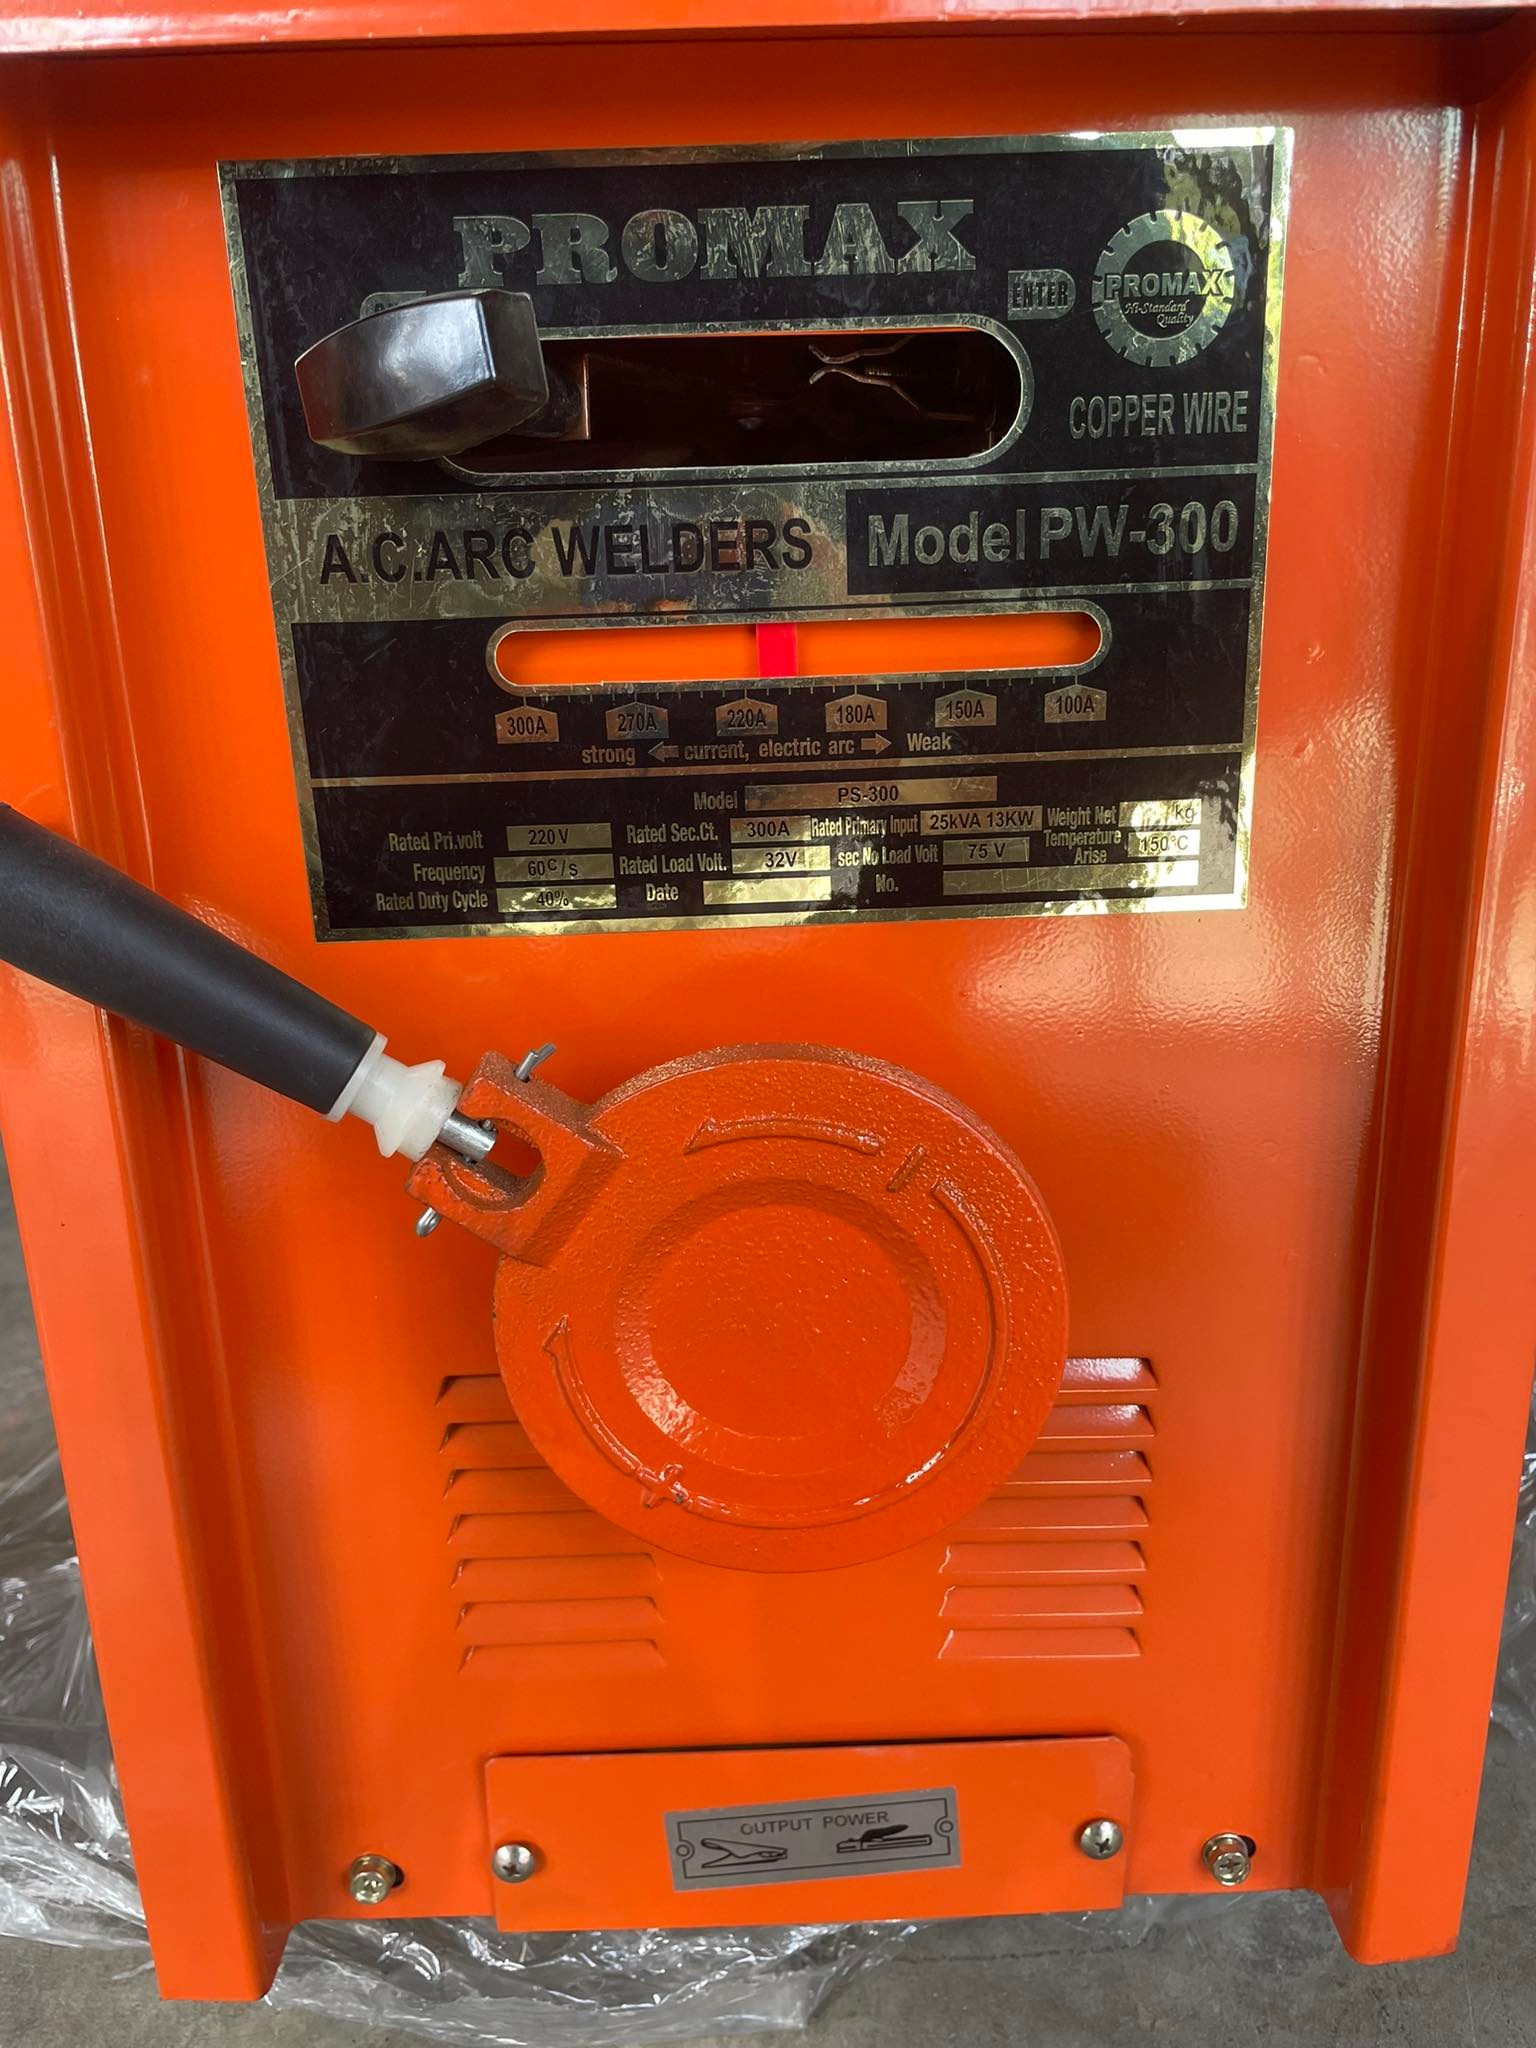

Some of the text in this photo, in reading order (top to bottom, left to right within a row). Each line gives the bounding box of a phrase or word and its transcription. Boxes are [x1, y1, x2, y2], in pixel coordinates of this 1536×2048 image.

[452, 199, 977, 288] PROMAX
[1013, 281, 1069, 308] ENTER
[1105, 271, 1223, 298] PROMAX
[1124, 300, 1190, 315] Hi-Standard
[1156, 312, 1194, 328] Quality
[1069, 389, 1249, 440] COPPER WIRE
[867, 499, 1239, 567] Model PW-300
[551, 517, 813, 578] WELDERS
[836, 704, 876, 725] 180A
[946, 699, 985, 720] 150A
[1055, 693, 1095, 715] 100A
[507, 715, 547, 737] 300A
[617, 712, 657, 733] 270A
[727, 708, 767, 729] 220A
[582, 732, 952, 766] strong current, electric arc Weak
[694, 785, 899, 810] Model PS-300
[930, 810, 1034, 831] 25kVA 13KW
[1047, 806, 1117, 829] Weight Net
[1175, 804, 1196, 823] kg
[627, 822, 719, 844] Rated Sec.Ct.
[747, 820, 790, 838] 300A
[811, 814, 919, 838] Rated Primary Input
[388, 830, 483, 851] Rated Pri.volt
[1044, 828, 1122, 848] Temperature
[619, 852, 727, 875] Rated Load Volt.
[765, 851, 798, 868] 32V
[838, 844, 939, 867] sec No Load Volt
[1074, 848, 1107, 865] Arise
[413, 863, 486, 885] Frequency
[875, 873, 899, 893] No.
[376, 889, 489, 914] Rated Duty Cycle
[537, 890, 569, 906] 40%
[645, 883, 679, 902] Date
[740, 1811, 889, 1836] OUTPUT POWER
